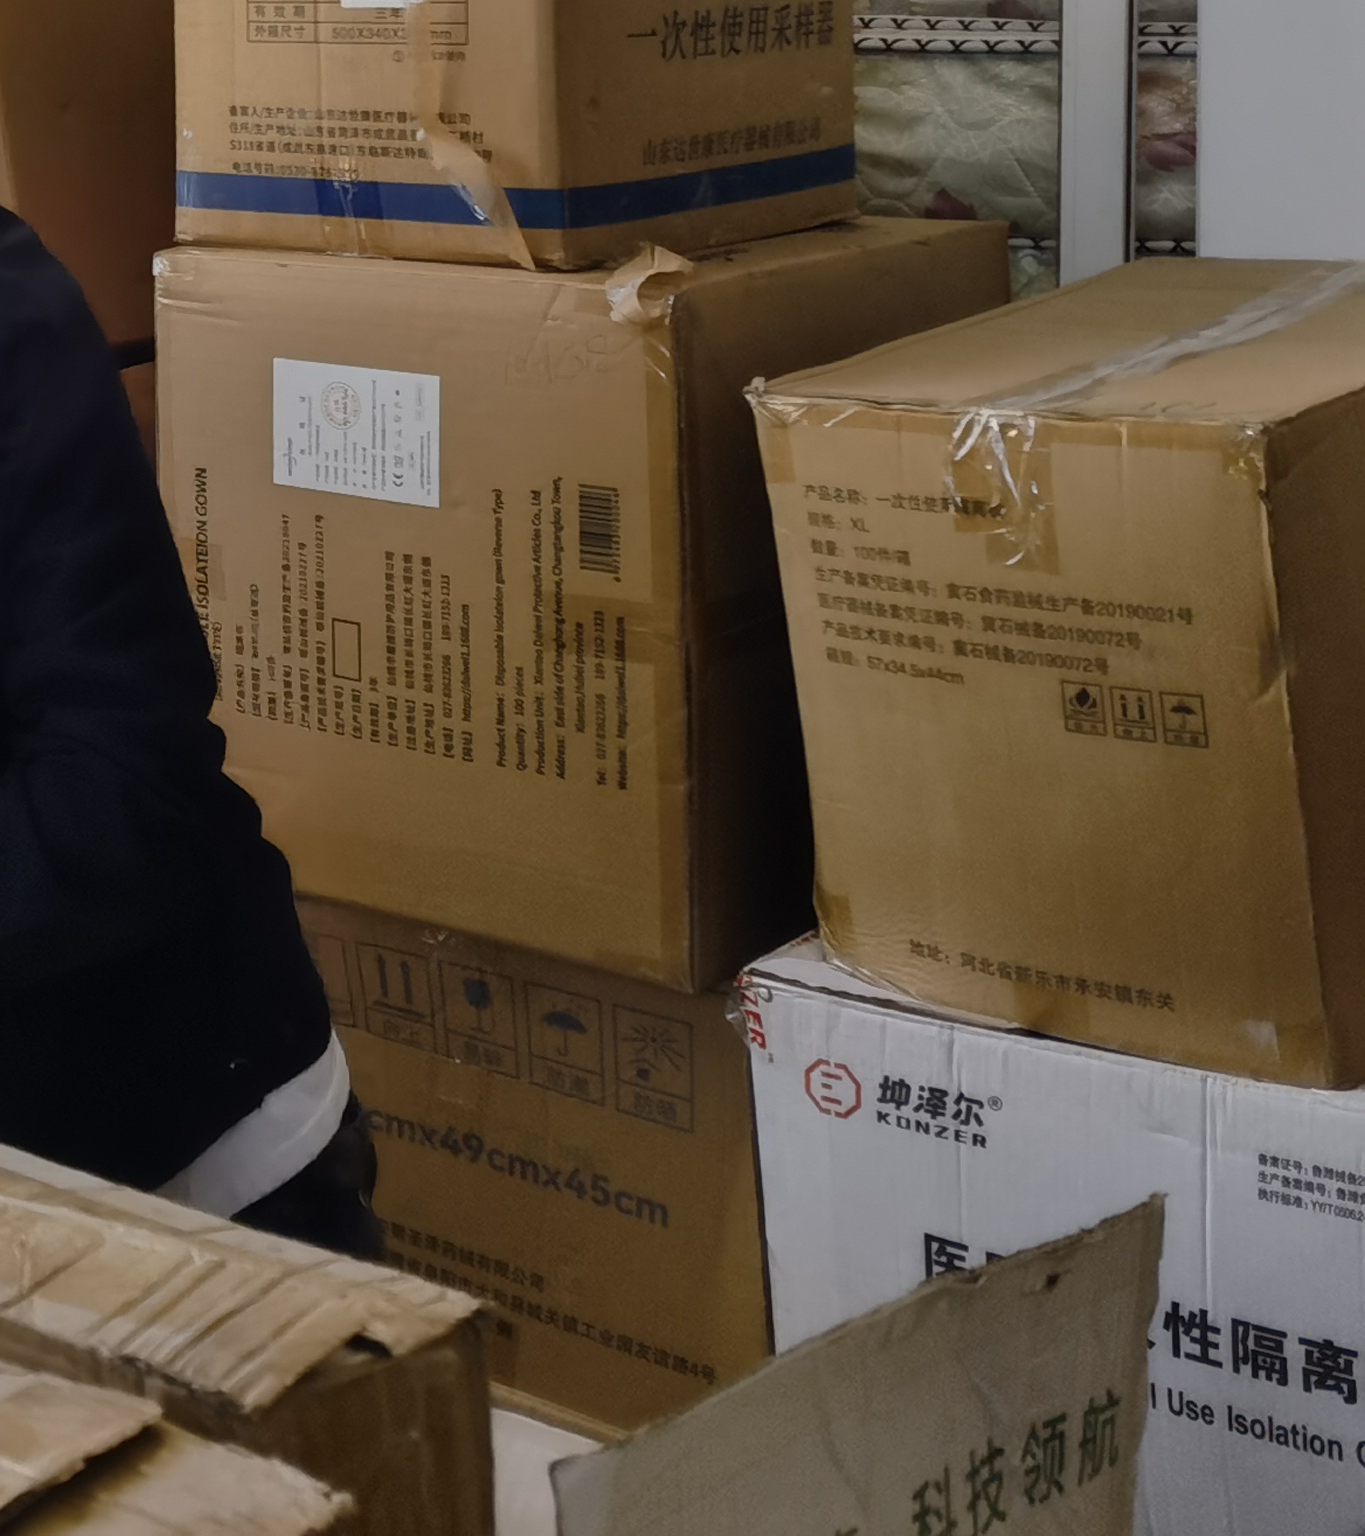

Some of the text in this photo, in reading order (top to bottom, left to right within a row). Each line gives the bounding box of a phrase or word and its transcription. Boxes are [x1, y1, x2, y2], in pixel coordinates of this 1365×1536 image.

[626, 0, 834, 62] 一次性使用采样器
[194, 467, 208, 517] GOWN
[876, 1074, 985, 1128] 坤泽尔
[876, 1110, 987, 1149] KONZER
[1167, 1385, 1344, 1463] Use Isolation
[910, 1389, 1122, 1536] 科技领航
